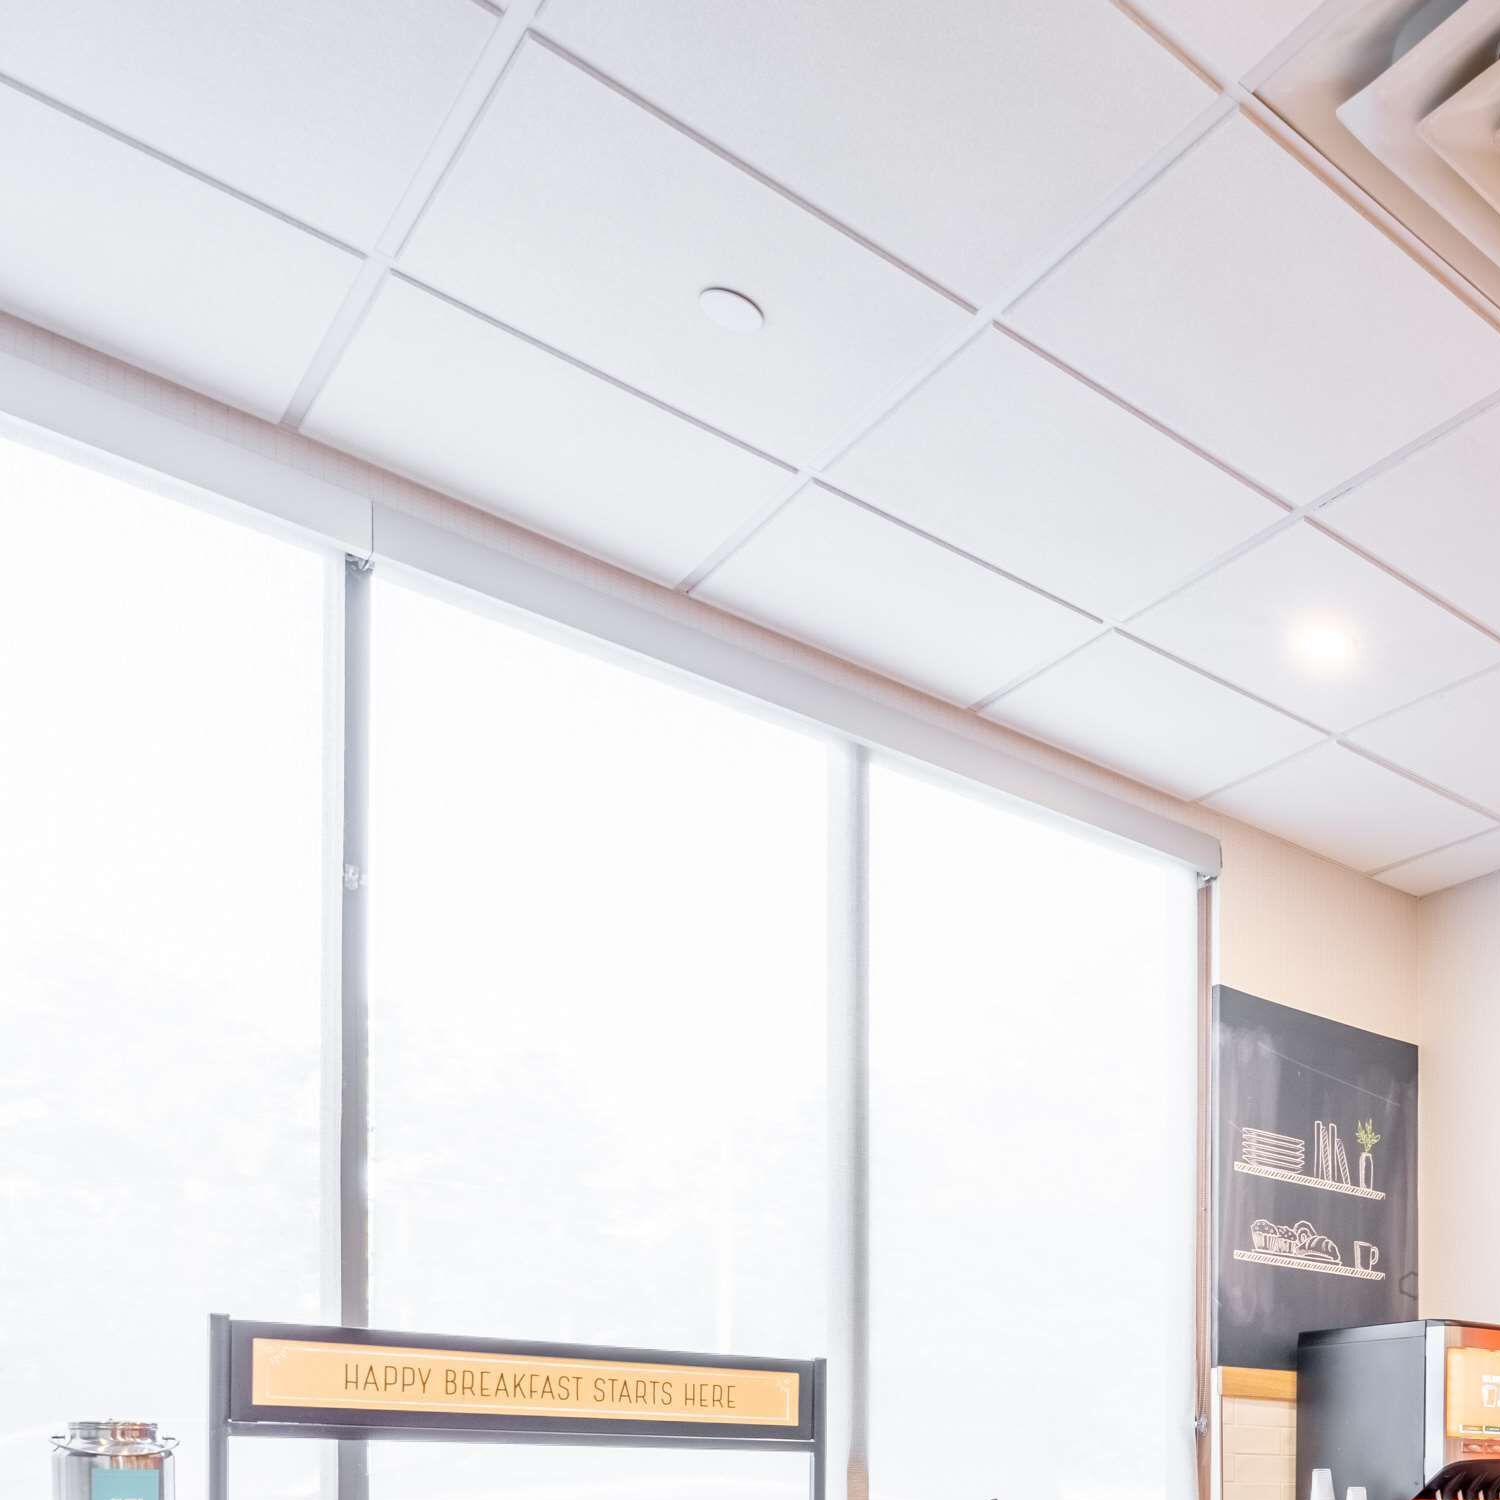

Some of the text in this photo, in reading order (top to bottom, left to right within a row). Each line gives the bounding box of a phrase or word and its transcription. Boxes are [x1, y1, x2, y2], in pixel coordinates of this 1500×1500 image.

[344, 1363, 737, 1409] HAPPY BREAKFAST STARTS HERE
